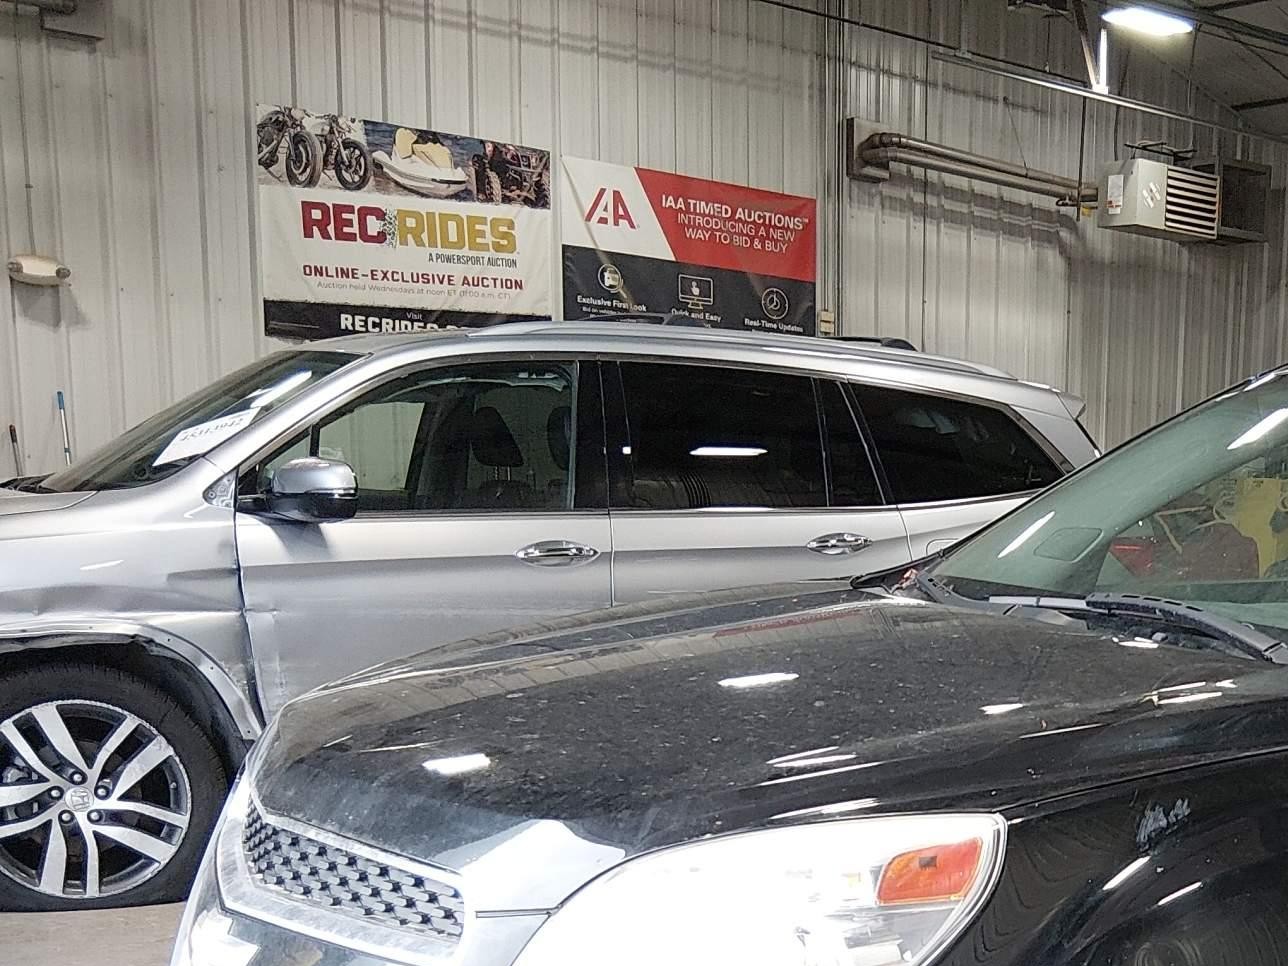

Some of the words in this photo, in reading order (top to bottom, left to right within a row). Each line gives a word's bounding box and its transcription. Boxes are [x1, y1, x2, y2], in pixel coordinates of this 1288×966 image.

[662, 194, 686, 210] IAA
[688, 199, 732, 218] TIMED
[677, 212, 755, 235] INTRODUCING
[758, 226, 767, 237] A
[769, 228, 796, 242] NEW
[685, 227, 711, 240] WAY
[714, 231, 730, 244] TO
[733, 233, 750, 247] BID
[753, 237, 762, 250] &
[765, 240, 788, 254] BUY
[428, 252, 434, 262] A
[435, 253, 485, 266] POWERSPORT
[486, 257, 518, 269] AUCTION
[303, 264, 455, 286] ONLINE-EXCLUSIVE
[461, 275, 524, 290] AUCTION
[317, 280, 348, 290] Auction
[576, 295, 612, 307] Exclusive
[406, 311, 423, 320] Visit
